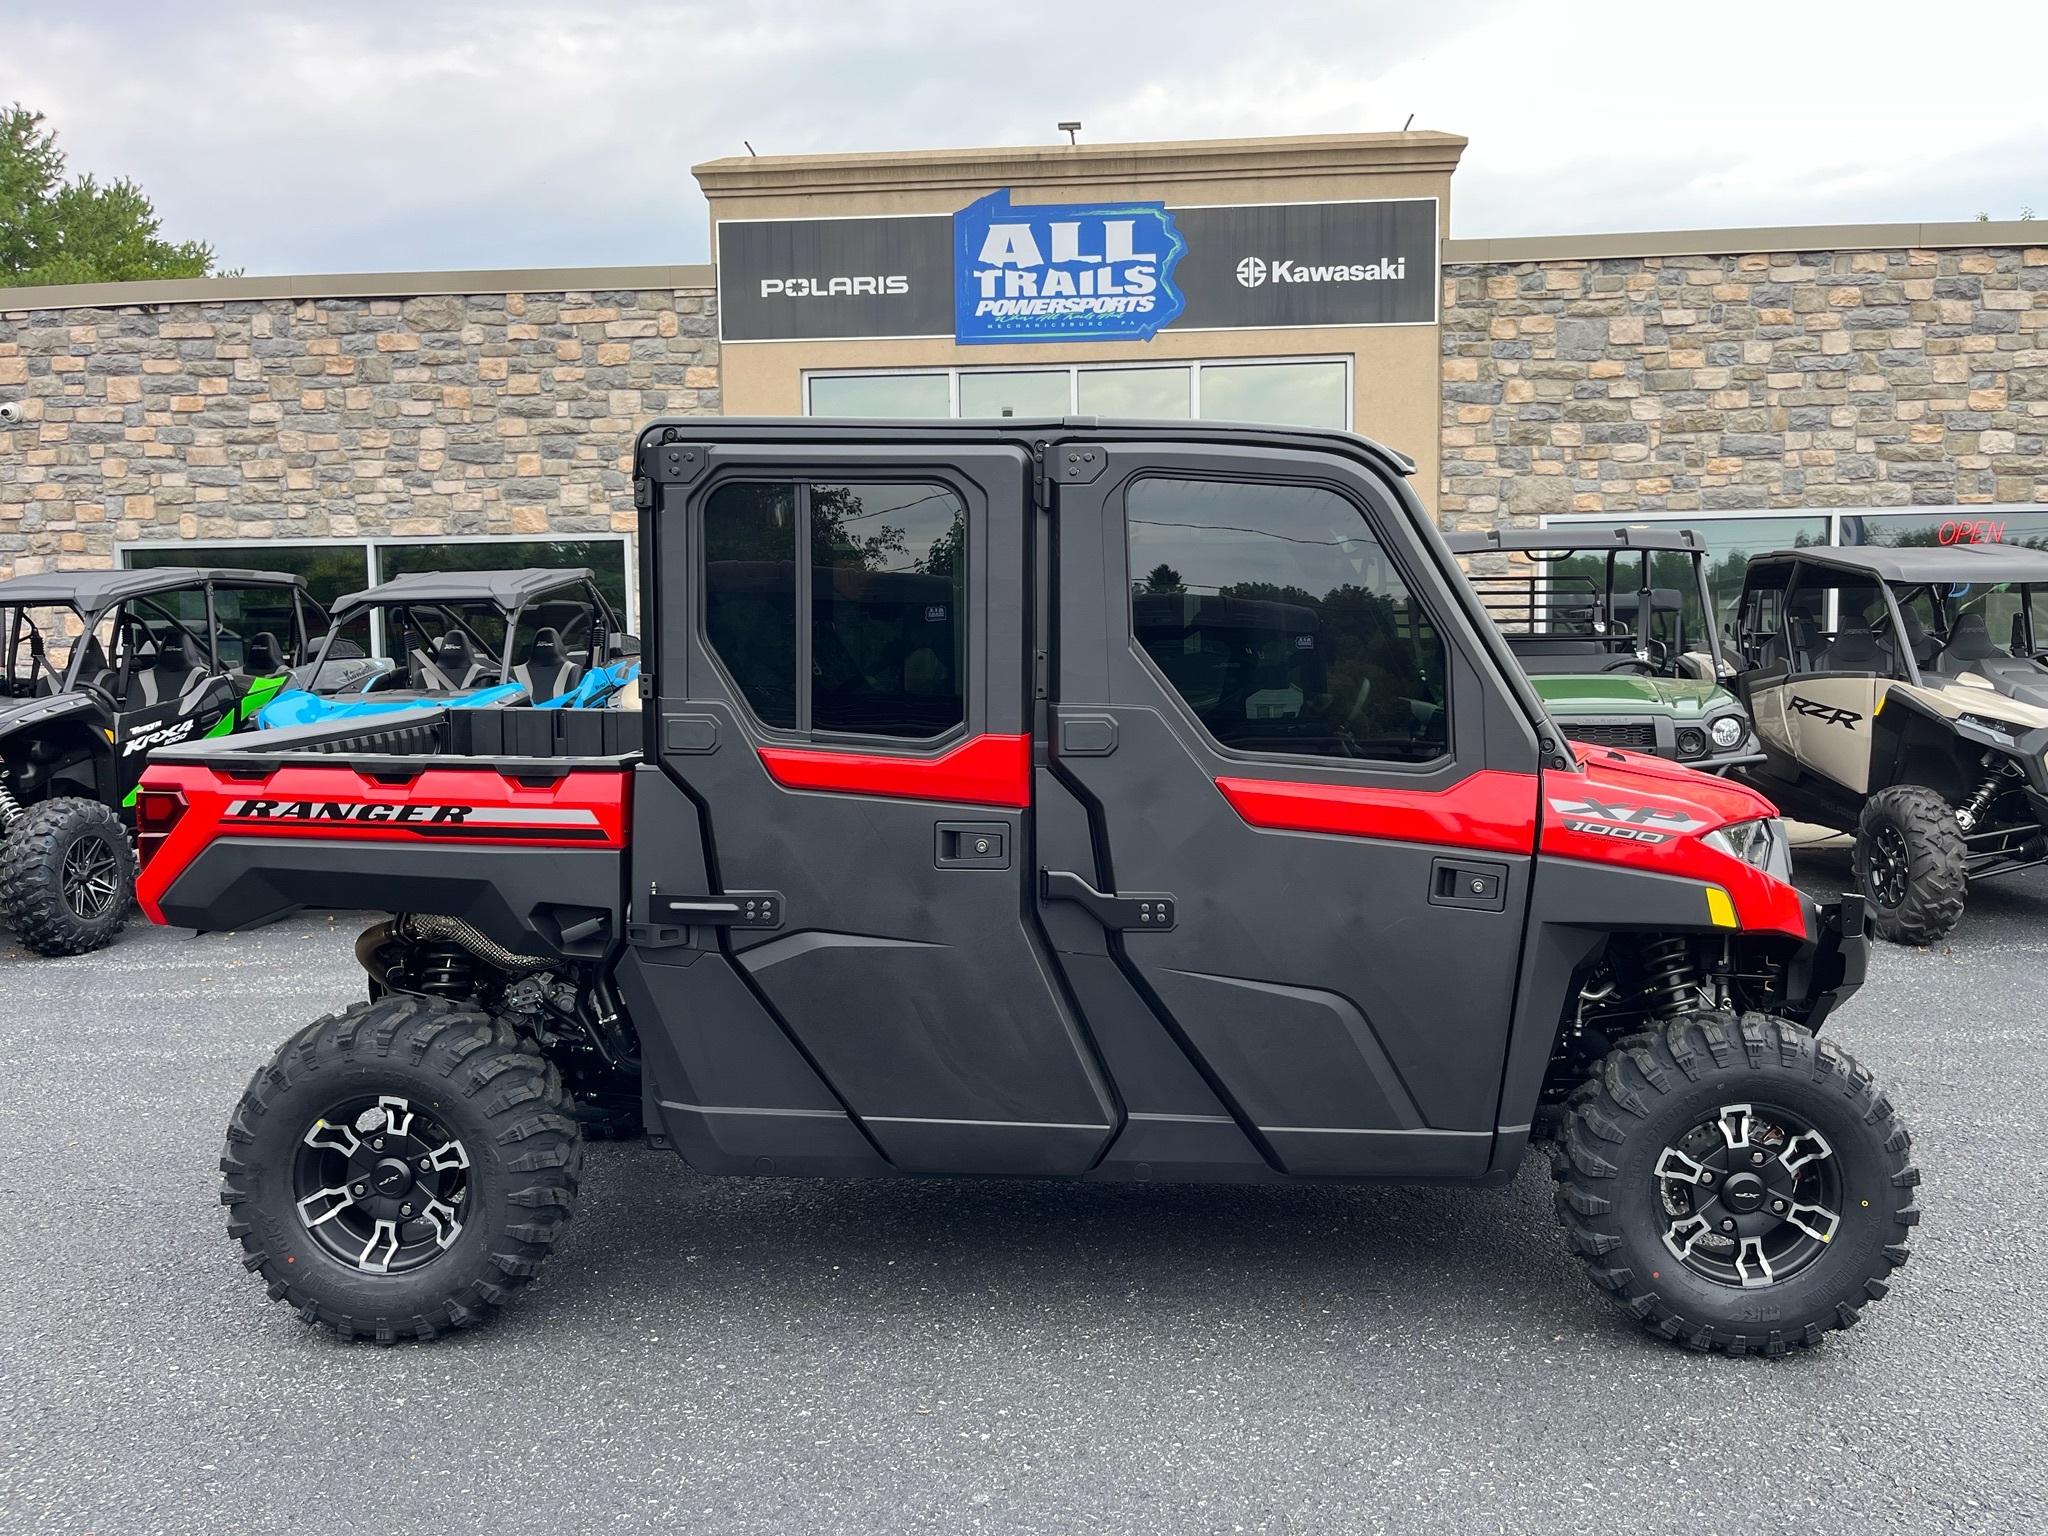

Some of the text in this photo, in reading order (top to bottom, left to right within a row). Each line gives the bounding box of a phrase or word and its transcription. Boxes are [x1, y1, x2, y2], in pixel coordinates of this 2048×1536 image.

[978, 220, 1157, 268] ALL
[973, 266, 1157, 298] TRAILS
[1272, 257, 1405, 283] Kawasaki
[761, 275, 909, 297] POLARIS
[975, 295, 1156, 316] POWERSPORTS
[1938, 520, 2006, 545] OPEN
[1787, 695, 1863, 731] RZR
[122, 719, 194, 757] KRX4
[164, 732, 188, 745] 1000
[235, 800, 473, 824] RANGER
[1561, 796, 1692, 824] XP
[1820, 800, 1858, 821] POLARIS
[1571, 821, 1664, 843] 1000
